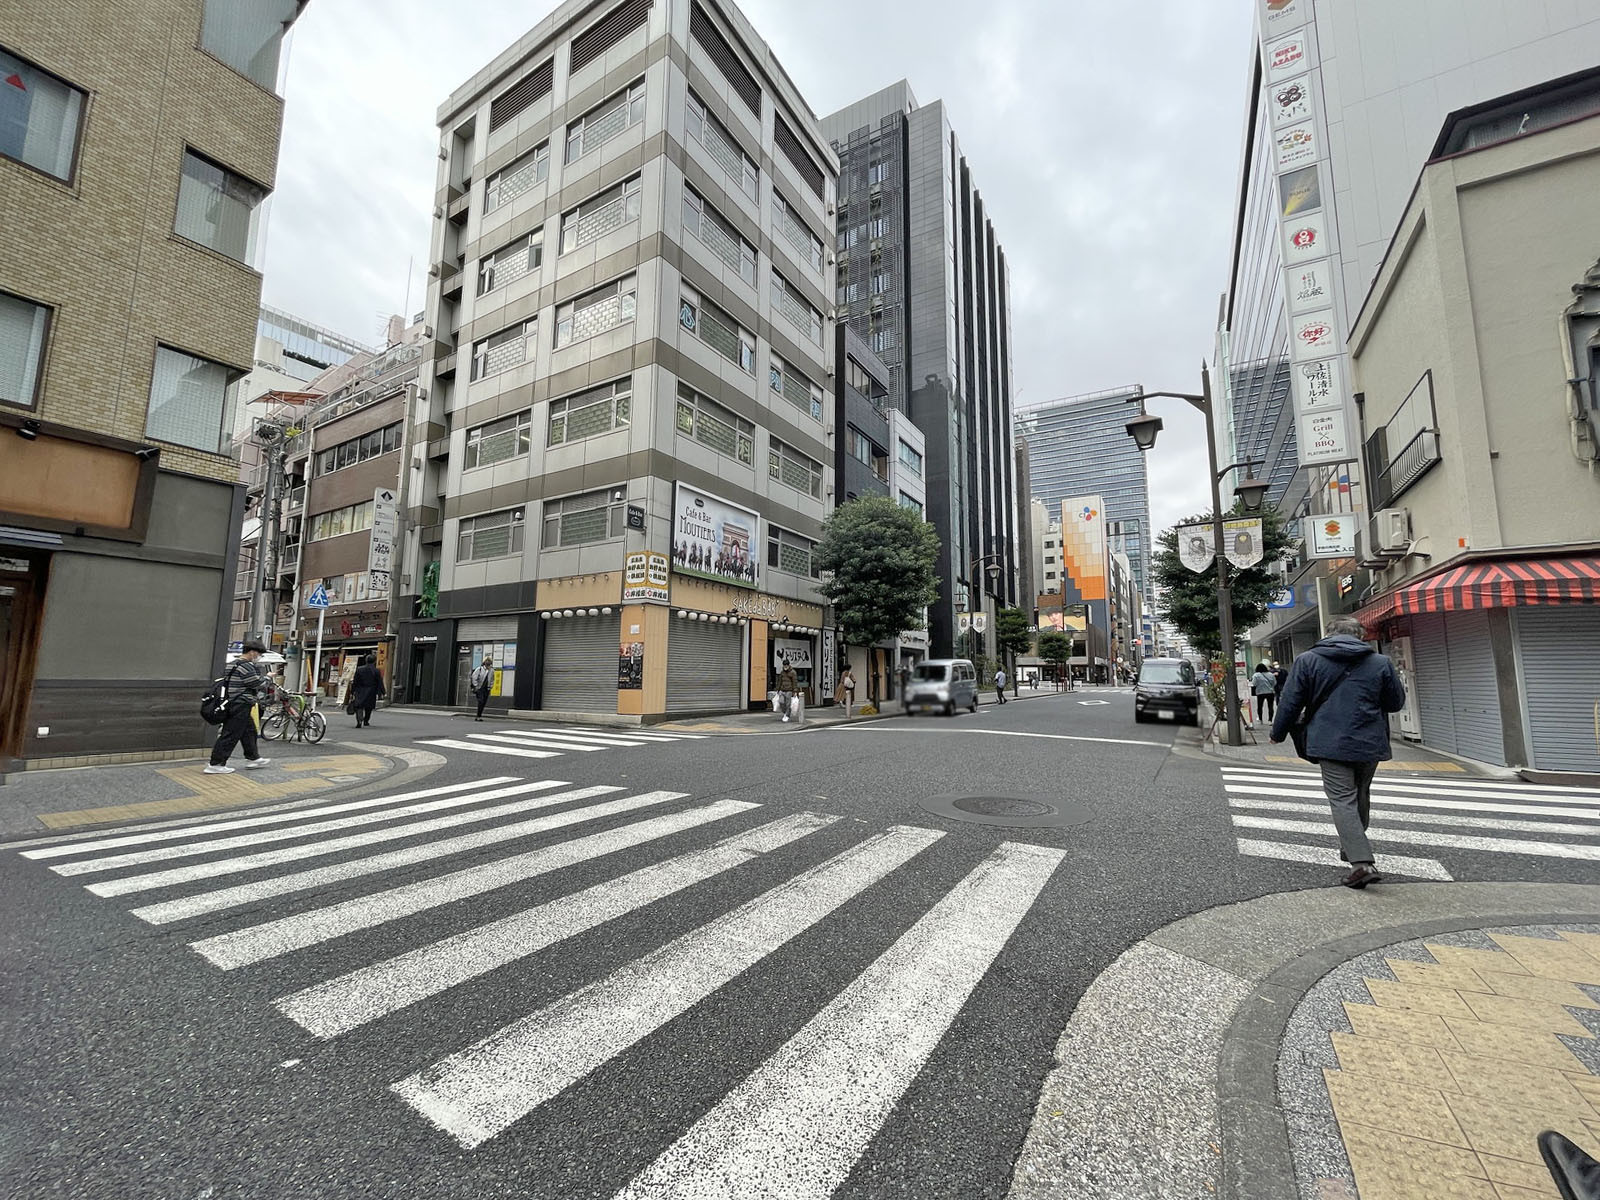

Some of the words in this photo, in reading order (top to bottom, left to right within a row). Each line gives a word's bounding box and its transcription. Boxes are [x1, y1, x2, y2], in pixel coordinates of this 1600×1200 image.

[1275, 45, 1297, 58] NIKU
[1271, 52, 1303, 68] AZABU
[1315, 362, 1329, 397] 土佐清水
[1307, 374, 1318, 405] ワールド
[1313, 423, 1333, 432] Grill
[1314, 439, 1335, 448] BBQ
[1331, 447, 1344, 455] MEAT
[685, 506, 698, 519] Cafe
[702, 512, 712, 523] Bar
[679, 515, 716, 543] MOUTIERS
